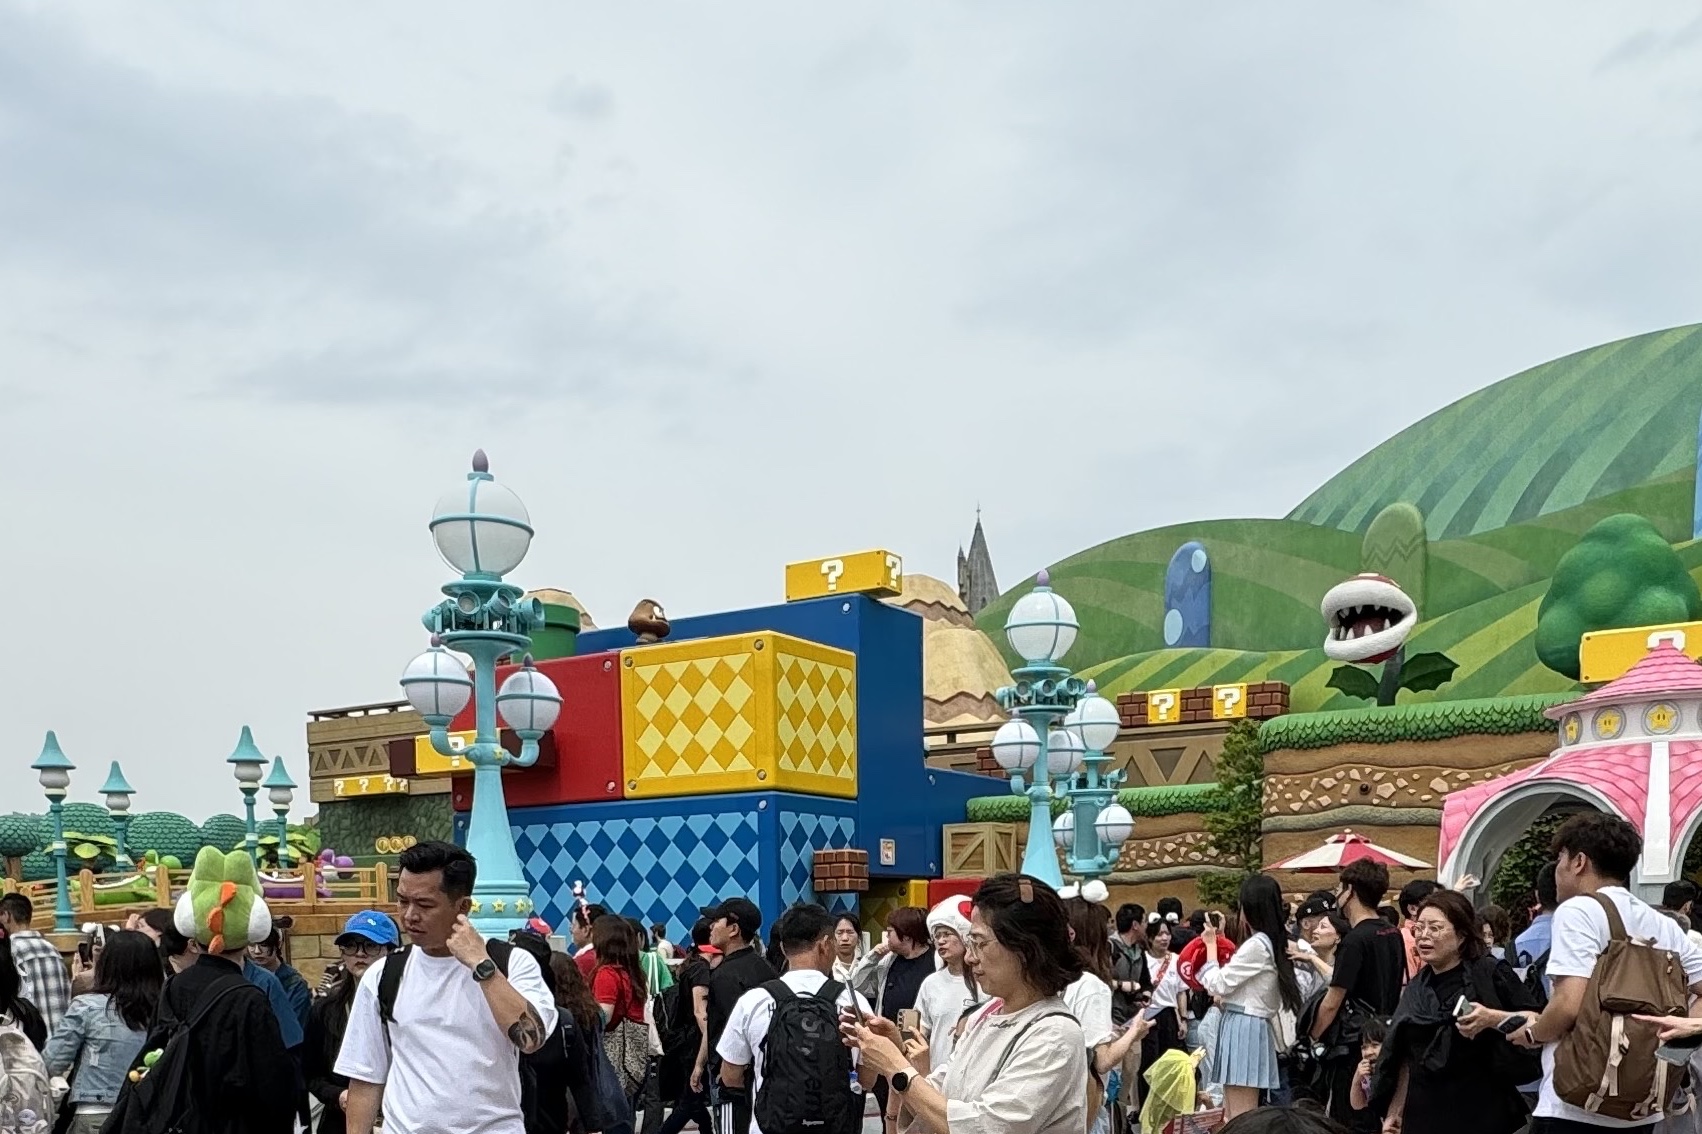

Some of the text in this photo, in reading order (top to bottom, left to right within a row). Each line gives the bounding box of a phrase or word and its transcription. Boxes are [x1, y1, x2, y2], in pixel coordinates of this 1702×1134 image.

[821, 560, 843, 591] ?
[886, 555, 901, 587] ?
[1152, 694, 1174, 720] ?
[1218, 688, 1240, 716] ?
